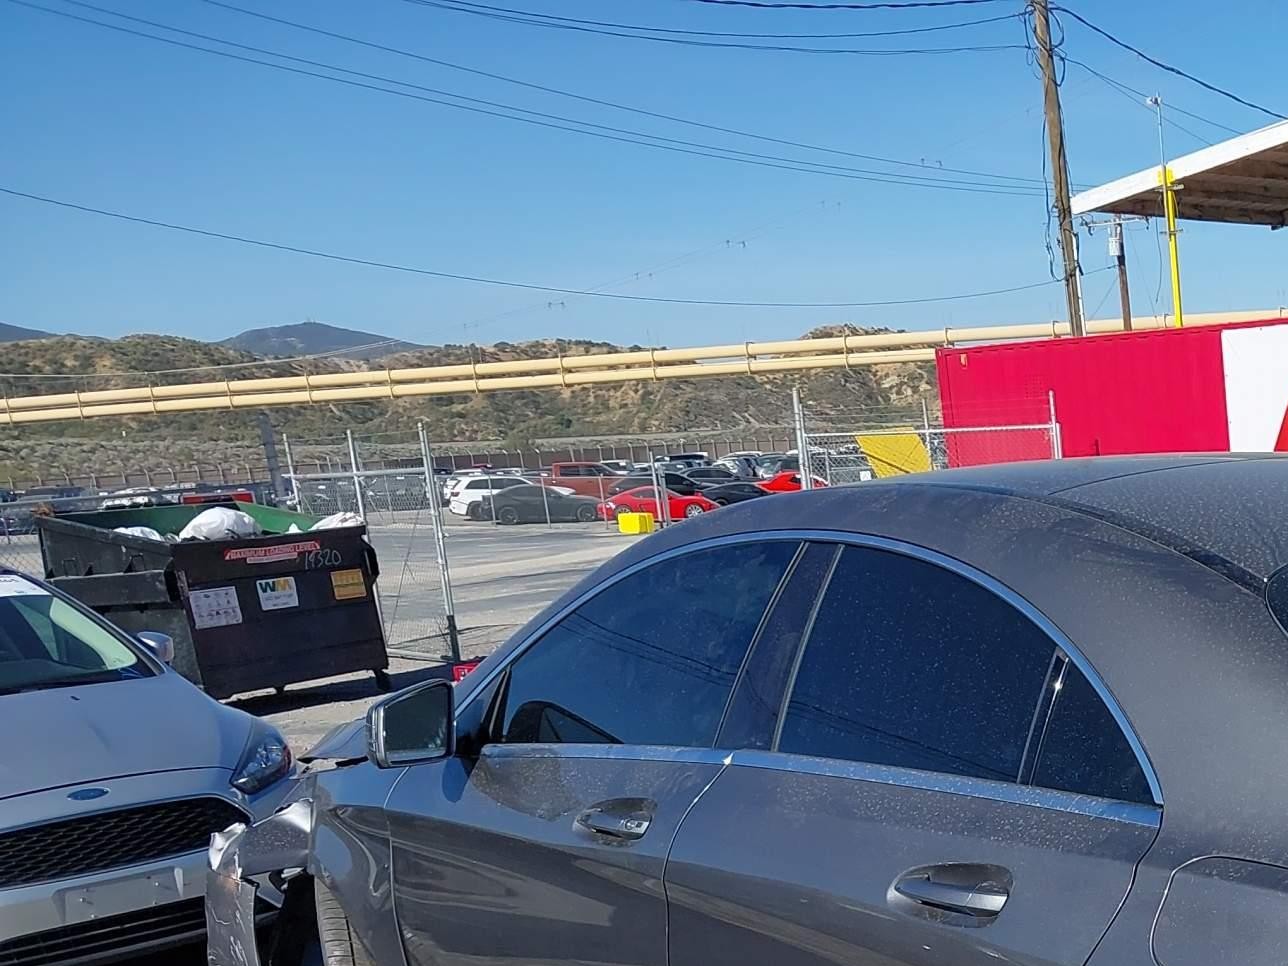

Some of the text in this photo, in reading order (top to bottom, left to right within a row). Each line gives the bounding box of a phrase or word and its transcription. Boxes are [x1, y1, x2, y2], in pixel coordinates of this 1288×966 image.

[231, 550, 264, 559] MAXIMUM
[296, 543, 317, 552] LEVEL
[259, 579, 289, 593] WM
